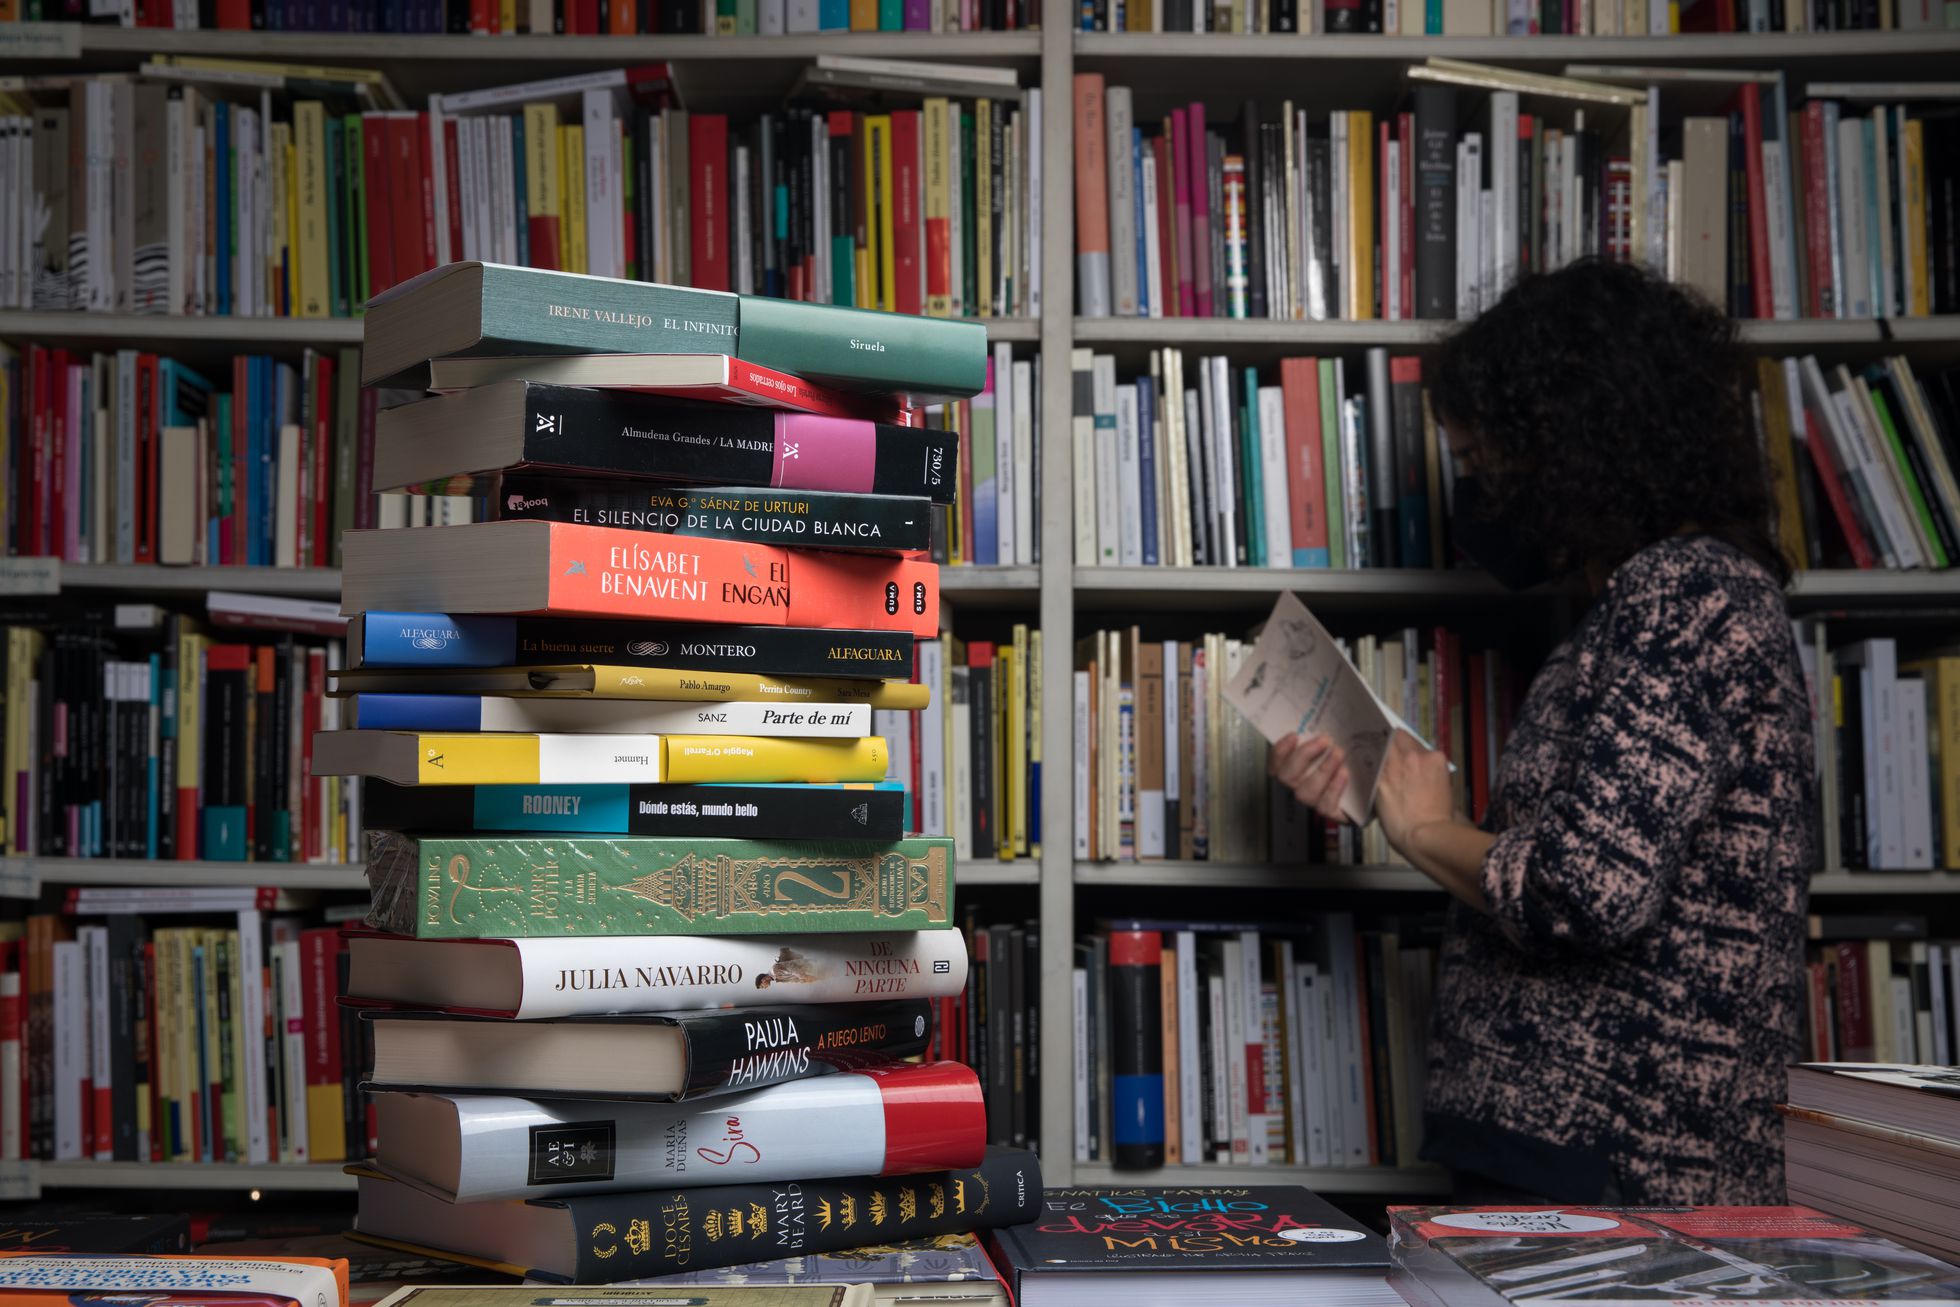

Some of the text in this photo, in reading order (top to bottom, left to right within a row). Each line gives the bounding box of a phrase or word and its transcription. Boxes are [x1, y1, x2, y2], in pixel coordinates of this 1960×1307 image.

[549, 305, 590, 320] IRENE
[594, 310, 652, 328] VALLEJO
[664, 318, 680, 330] EL
[850, 339, 885, 352] Siruela
[622, 427, 670, 441] Almudena
[672, 432, 711, 445] Grandes
[719, 437, 734, 448] LA
[931, 447, 943, 485] 730/5
[651, 496, 674, 508] EVA
[700, 494, 740, 511] SÁENZ
[744, 500, 760, 512] DE
[764, 501, 809, 514] URTURI
[574, 509, 882, 537] EL SILENCIO DE LA CIUDAD BLANCA
[610, 543, 701, 576] ELÍSABET
[770, 562, 789, 583] EL
[601, 571, 709, 602] BENAVENT
[400, 628, 460, 640] ALFAGUARA
[523, 639, 615, 654] La buena suerte
[680, 643, 756, 657] MONTERO
[827, 647, 903, 661] ALFAGUARA
[680, 679, 731, 692] Pablo Amargo
[759, 683, 812, 697] Perrita Country
[698, 713, 727, 723] SANZ
[762, 710, 854, 726] Parte de mí
[614, 754, 649, 765] Hamnet
[723, 747, 754, 756] Maggie
[523, 794, 581, 815] ROONEY
[639, 800, 758, 817] Dónde estás, mundo bello
[427, 855, 441, 925] ROWLING
[530, 863, 546, 916] HARRY
[545, 860, 560, 918] POTTER
[896, 860, 904, 909] MINALIMA
[870, 941, 894, 956] DE
[555, 963, 743, 991] JULIA NAVARRO
[845, 959, 921, 977] NINGUNA
[854, 977, 908, 993] PARTE
[744, 1016, 799, 1051] PAULA
[817, 1024, 887, 1050] A FUEGO LENTO
[727, 1046, 811, 1087] HAWKINS
[665, 1124, 676, 1168] MARÍA
[676, 1119, 687, 1172] DUEÑAS
[697, 1115, 761, 1165] Sira
[1043, 1189, 1147, 1197] GNATIUS
[772, 1190, 789, 1246] MARY
[788, 1183, 805, 1249] BEARD
[662, 1203, 677, 1258] DOCE
